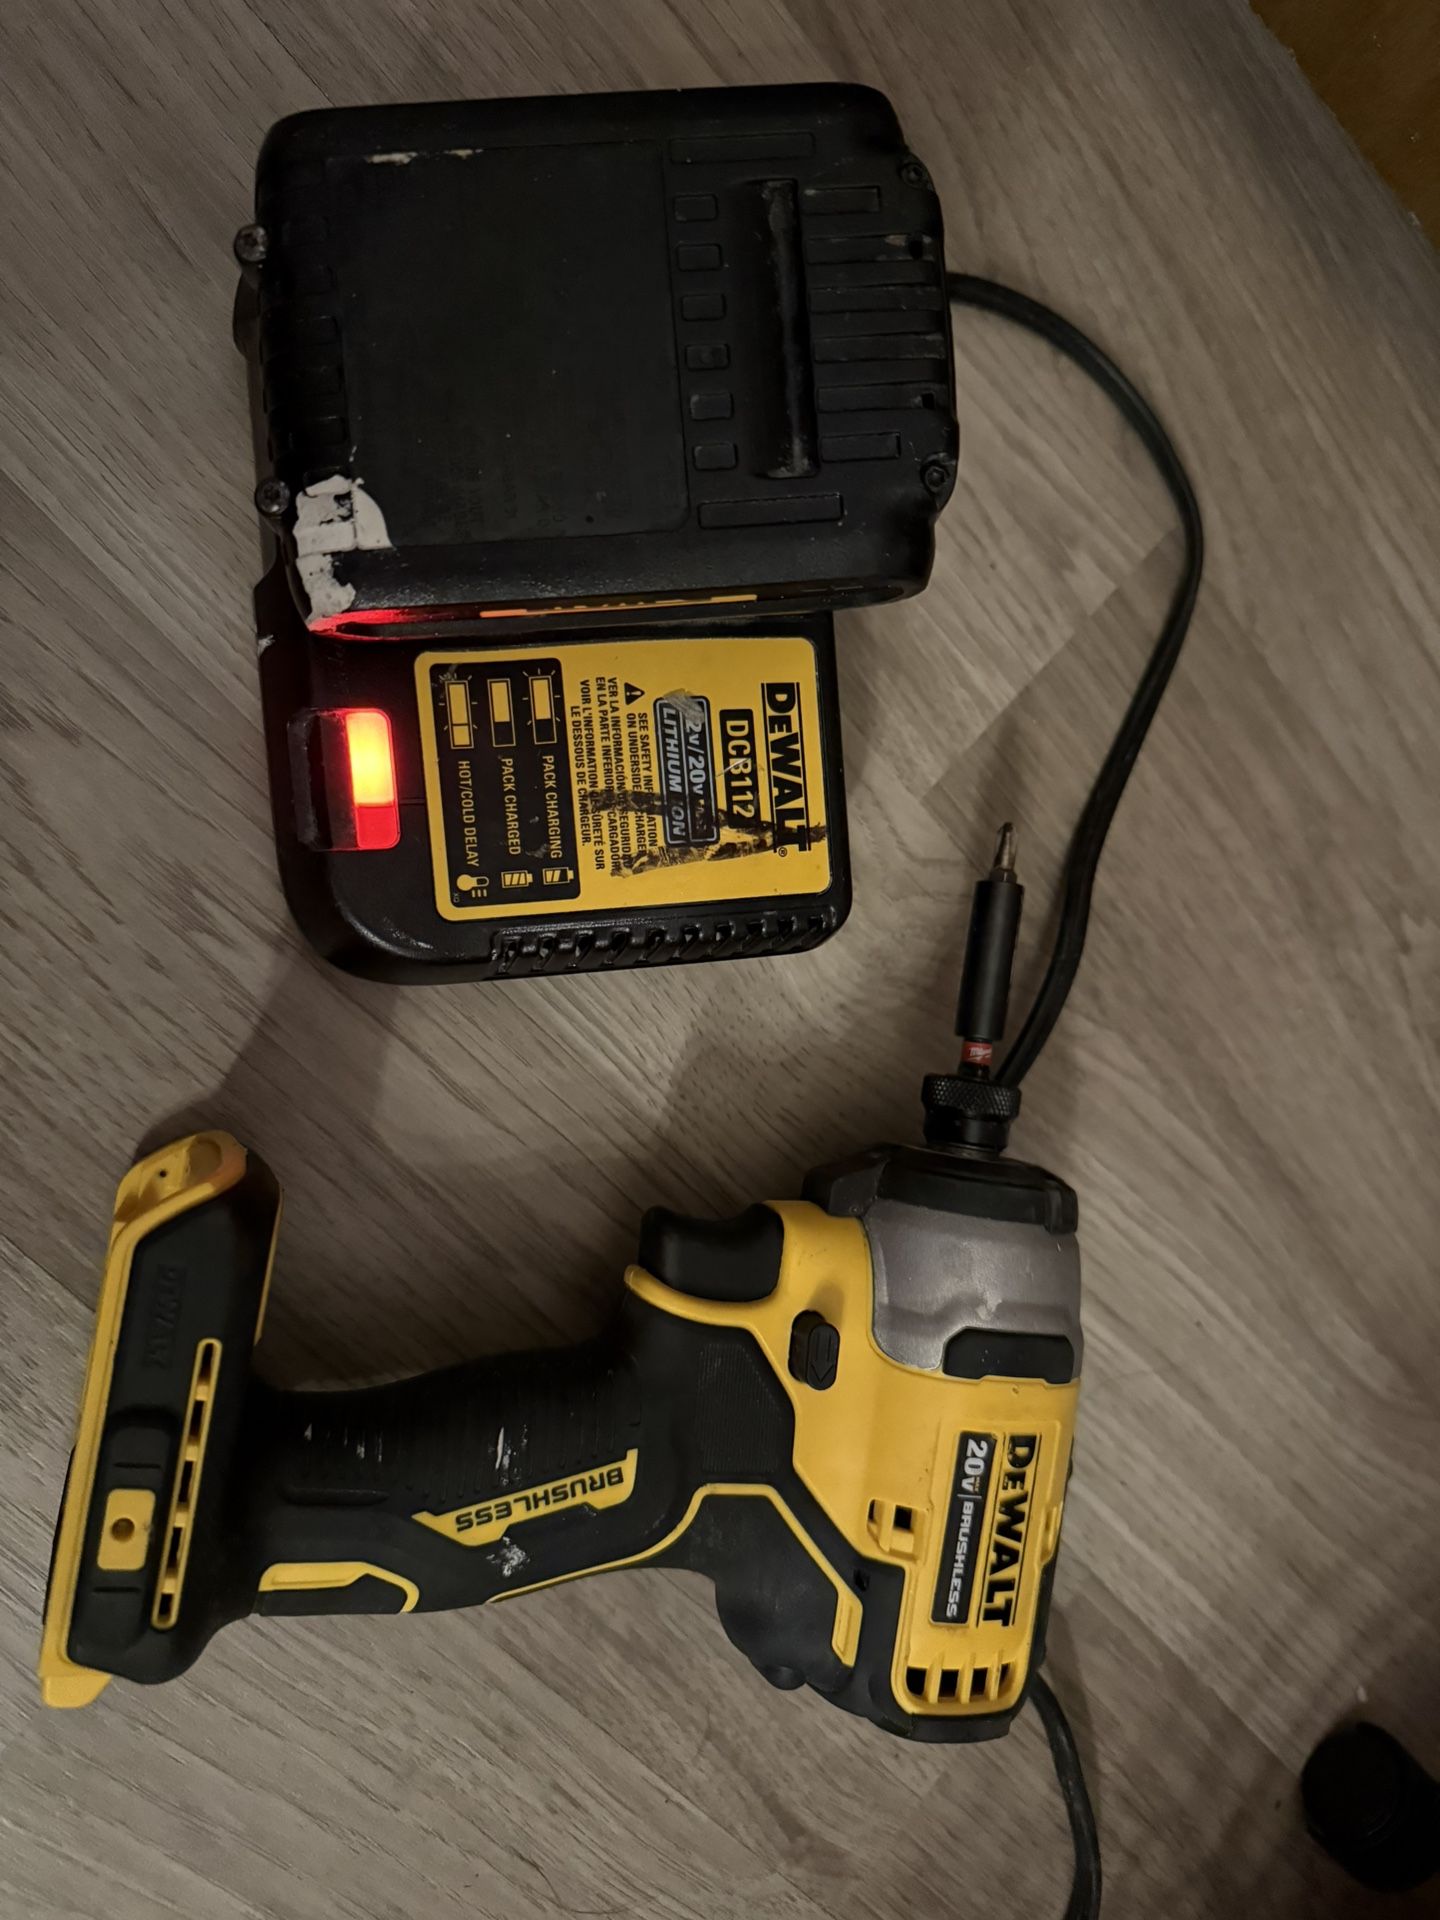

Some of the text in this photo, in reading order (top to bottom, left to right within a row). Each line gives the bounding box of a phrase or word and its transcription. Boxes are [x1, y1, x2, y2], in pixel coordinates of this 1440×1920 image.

[580, 680, 591, 704] VOIR
[596, 677, 607, 691] EN
[597, 694, 608, 706] LA
[607, 677, 618, 697] VER
[609, 701, 619, 713] LA
[583, 707, 598, 787] L'INFORMATION
[598, 710, 610, 742] PARTE
[611, 716, 628, 790] INFORMACIÓN
[626, 713, 637, 728] ON
[662, 707, 681, 792] LITHIUM
[685, 711, 706, 795] 2V/20V
[570, 706, 591, 847] LE DESSOUS DE CHARGEUR.
[602, 746, 614, 792] INFERIOR
[629, 731, 641, 790] UNDERSIDE
[638, 713, 657, 847] SEE SAFETY INFATION
[724, 720, 755, 818] DCB112
[765, 683, 808, 852] DEWALT
[457, 760, 479, 867] HOT/COLD DELAY
[500, 758, 520, 855] PACK CHARGED
[541, 755, 564, 859] PACK CHARGING
[591, 808, 606, 847] SÛRETÉ
[594, 850, 605, 870] SUR
[455, 1466, 624, 1533] BRUSHLESS
[960, 1439, 988, 1492] 20V
[945, 1501, 974, 1618] BRUSHLESS
[982, 1434, 1037, 1627] DEWALT
